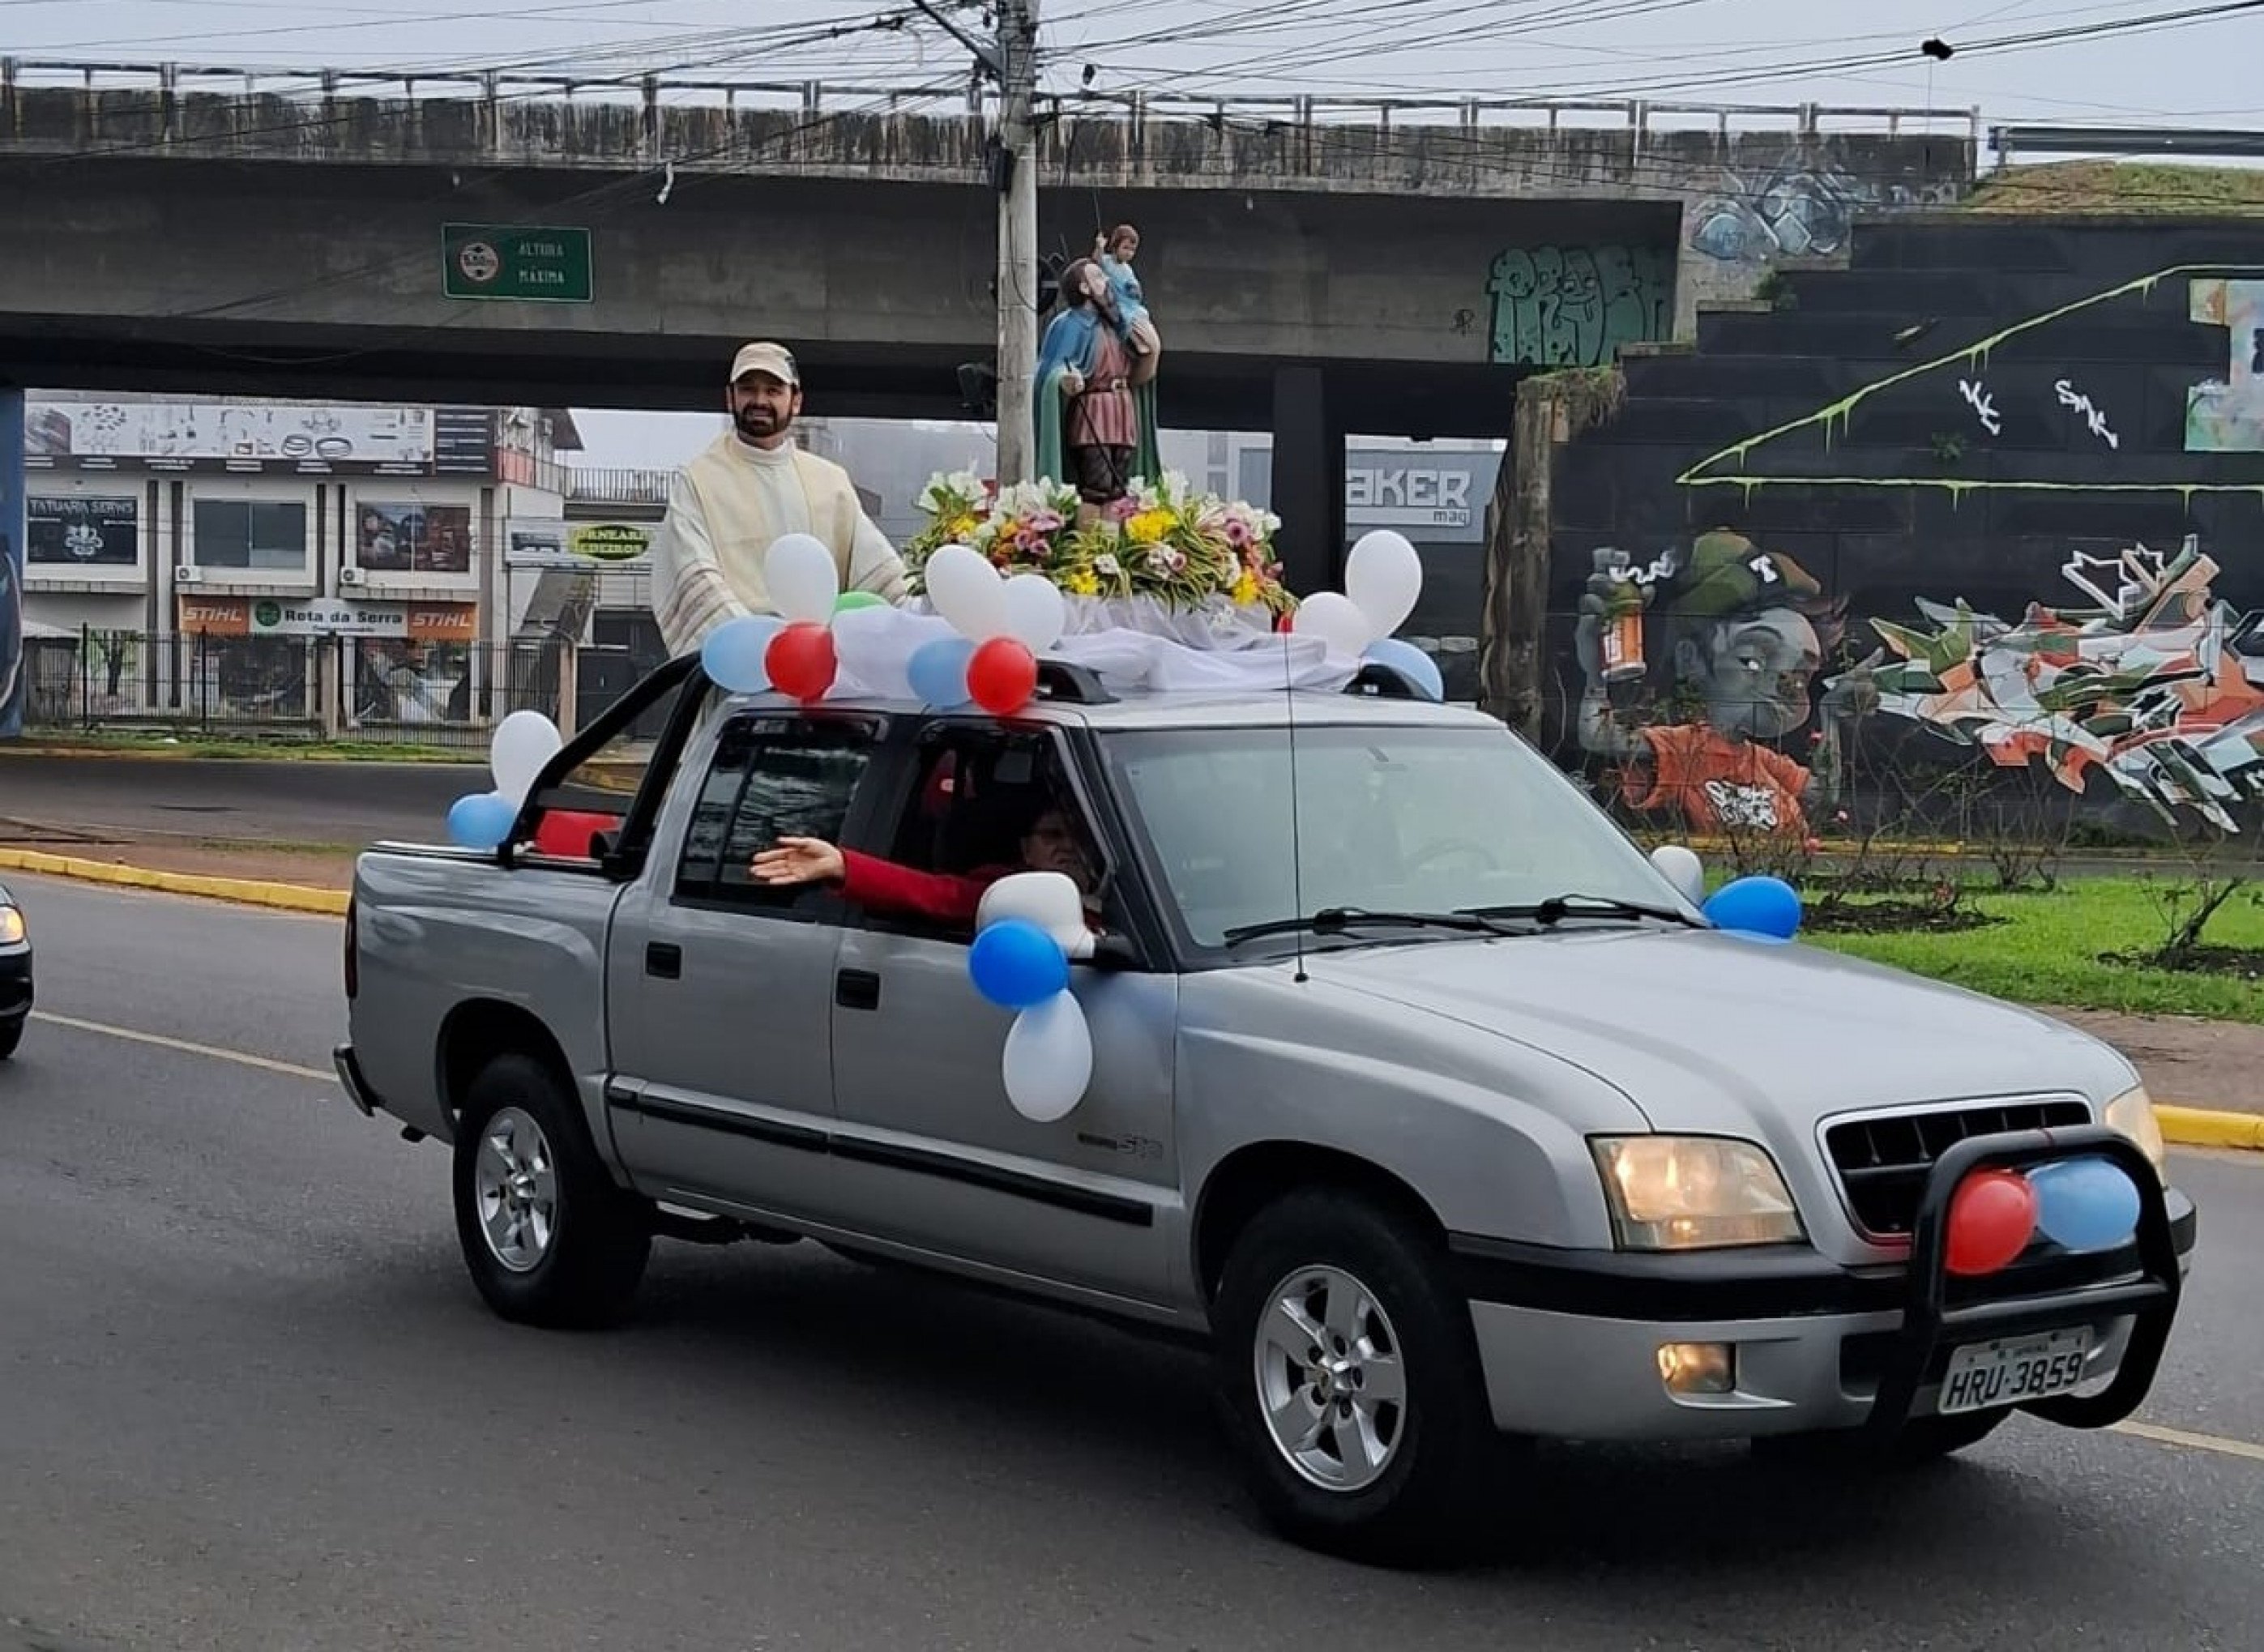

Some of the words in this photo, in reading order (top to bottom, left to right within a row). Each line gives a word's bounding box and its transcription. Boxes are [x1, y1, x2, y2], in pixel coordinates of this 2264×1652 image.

[182, 606, 242, 621] STIHL
[284, 609, 323, 622] Rota
[330, 610, 350, 623] da
[357, 610, 403, 623] Serra
[412, 612, 472, 627] STIHL
